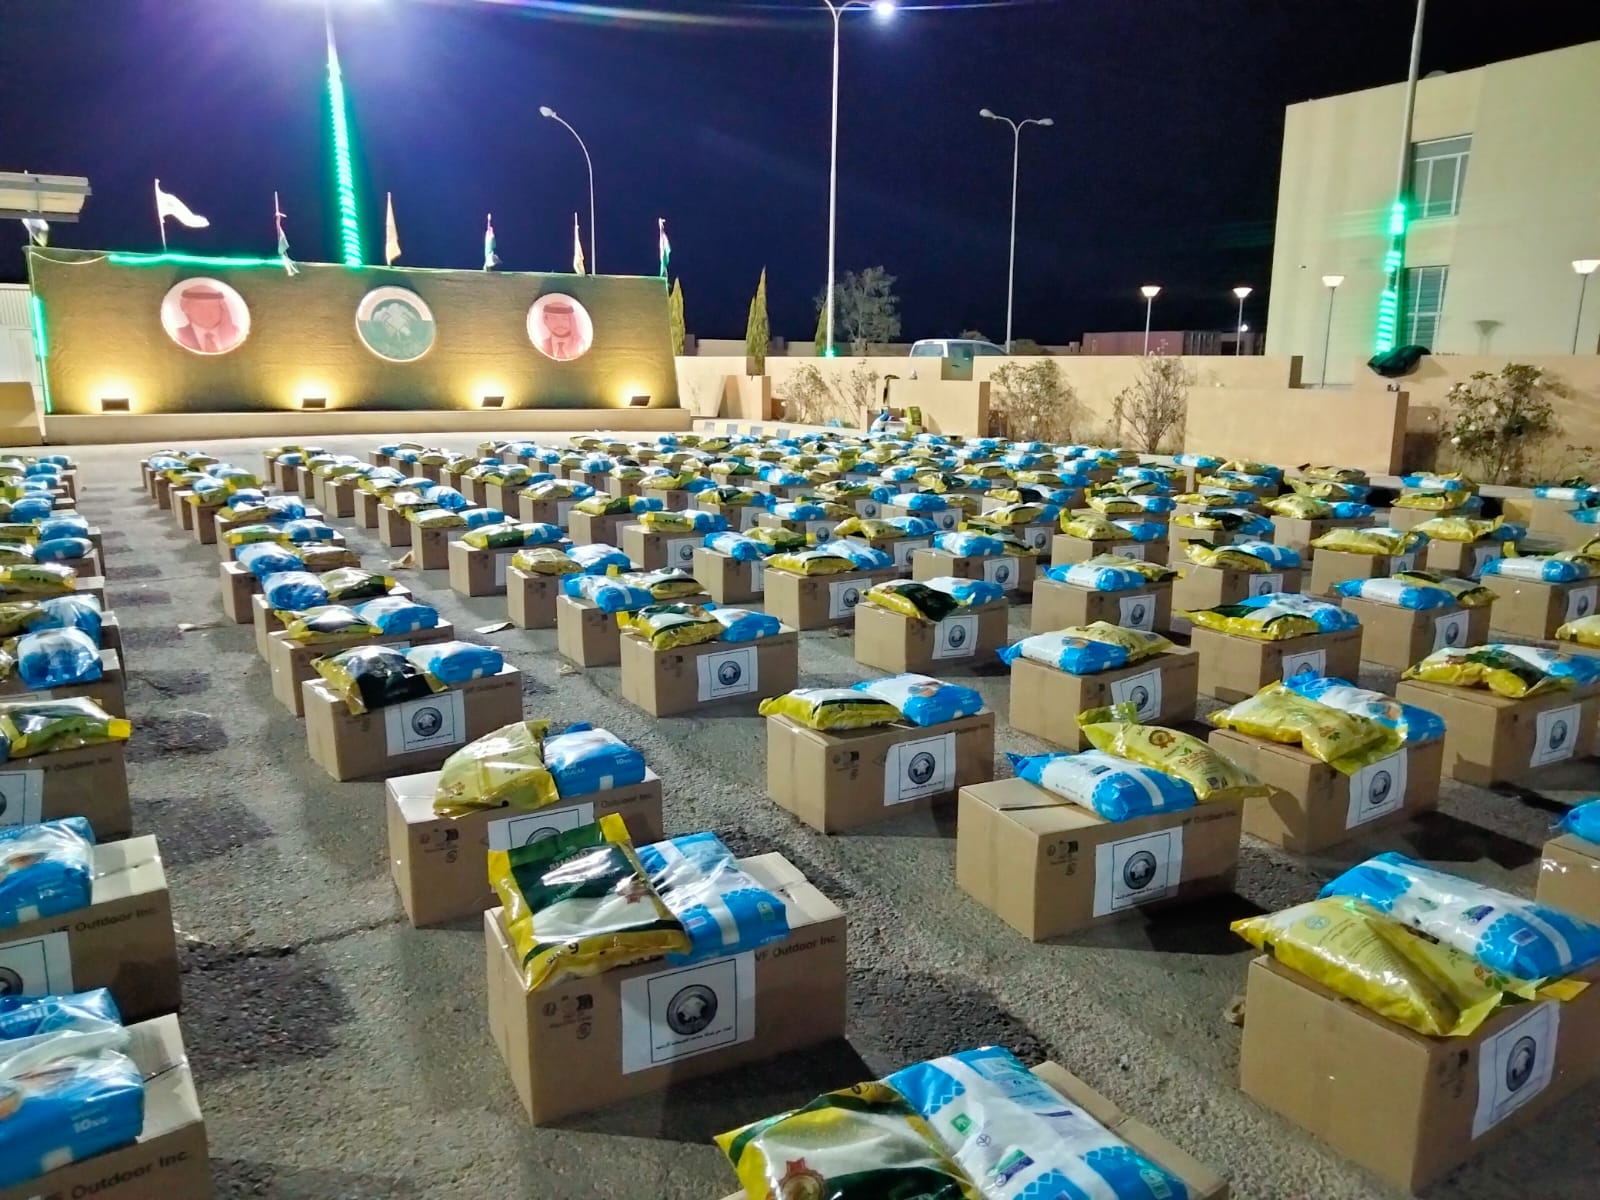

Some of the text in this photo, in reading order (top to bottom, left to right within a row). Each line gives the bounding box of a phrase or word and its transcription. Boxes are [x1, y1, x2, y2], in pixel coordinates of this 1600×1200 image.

[75, 912, 132, 932] Outdoor
[772, 939, 817, 958] Outdoor
[71, 1162, 153, 1199] Outdoor
